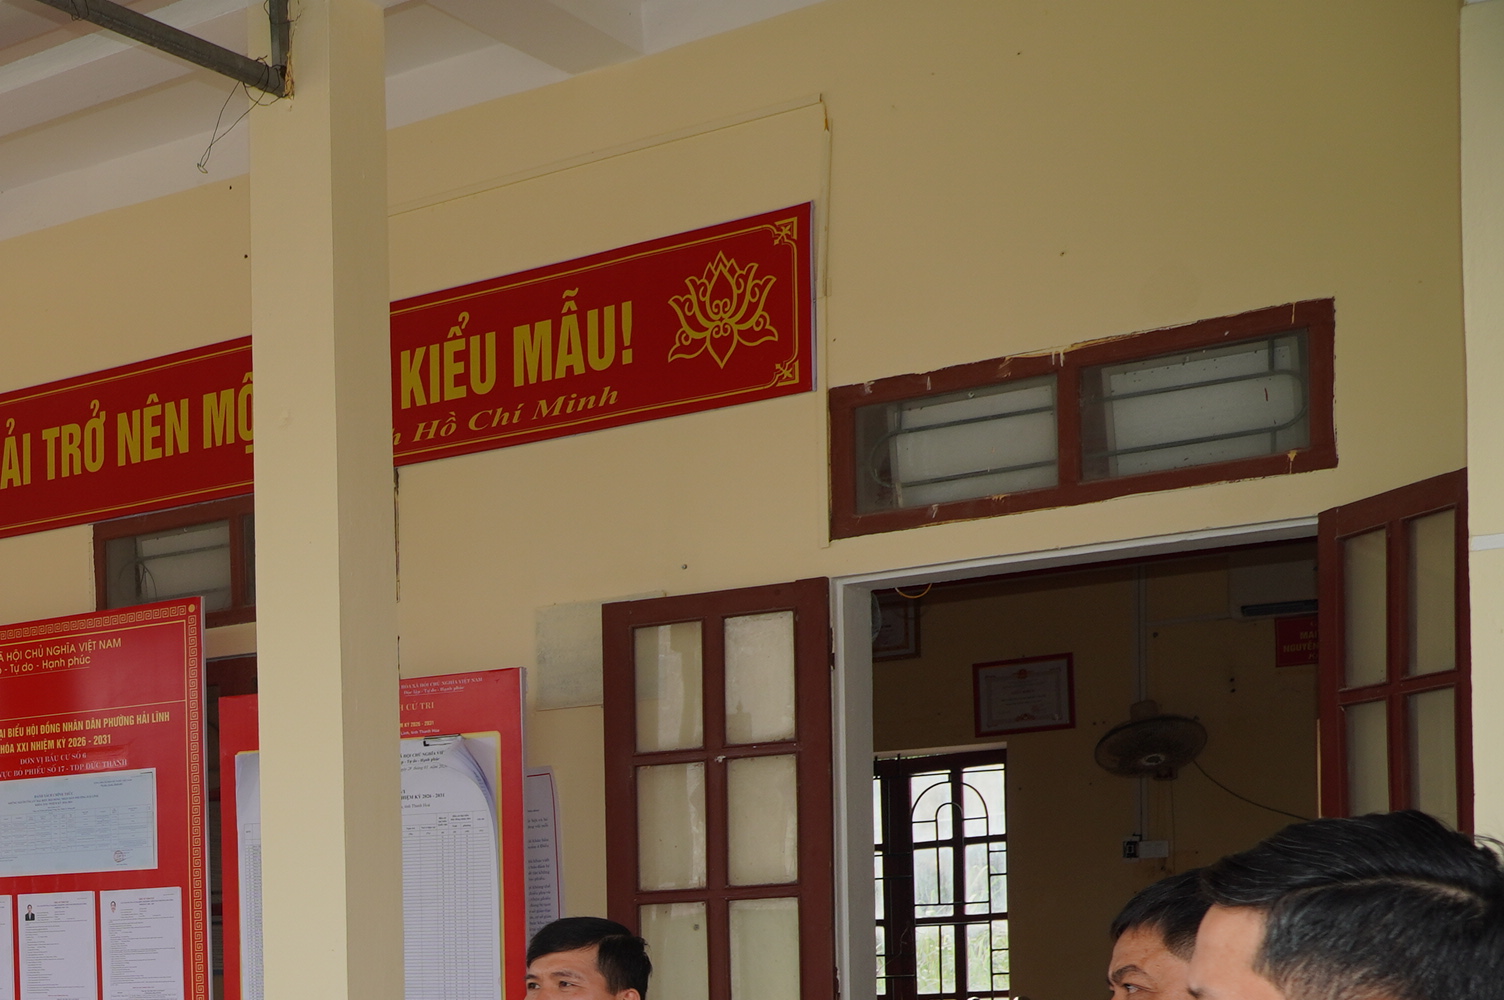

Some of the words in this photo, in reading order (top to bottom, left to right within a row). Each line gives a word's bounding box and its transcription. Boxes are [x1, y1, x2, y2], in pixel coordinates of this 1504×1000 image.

[41, 398, 108, 481] TRỞ
[117, 393, 190, 467] NÊN
[203, 371, 254, 454] MỘ
[400, 311, 497, 410] KIỂU
[513, 287, 634, 388] MẪU!
[411, 411, 457, 443] Hồ
[469, 401, 526, 432] Chí
[531, 386, 619, 421] Minh
[6, 649, 23, 663] HỘI
[24, 645, 44, 659] CHỦ
[46, 642, 76, 656] NGHĨA
[78, 639, 97, 653] VIỆT
[99, 638, 122, 650] NAM
[10, 663, 20, 675] Tự
[21, 662, 34, 672] do
[42, 657, 66, 671] Hạnh
[67, 654, 91, 668] phúc
[7, 722, 25, 737] BIỂU
[26, 722, 38, 737] HỘI
[40, 718, 61, 734] ĐỒNG
[62, 716, 84, 732] NHÂN
[86, 715, 101, 730] DÂN
[103, 713, 135, 729] PHƯỜNG
[136, 711, 150, 725] HẢI
[152, 711, 170, 723] LĨNH
[16, 741, 29, 754] XXI
[30, 737, 55, 753] NHIỆM
[56, 735, 67, 750] KỲ
[68, 735, 87, 747] 2026
[94, 734, 111, 746] 2031
[58, 765, 64, 773] 17
